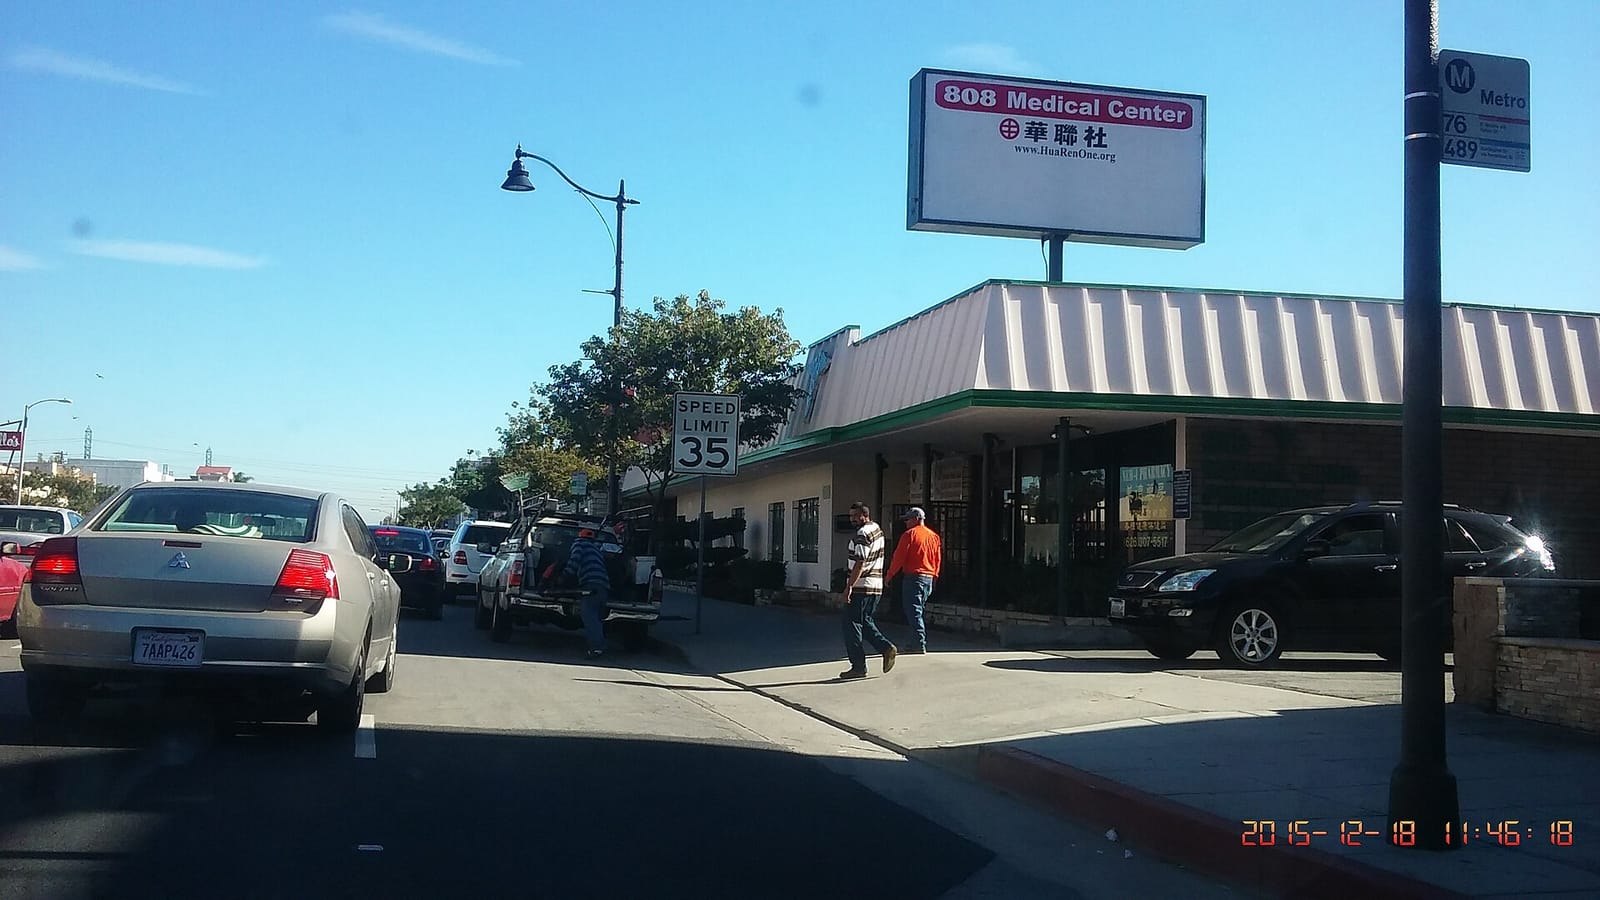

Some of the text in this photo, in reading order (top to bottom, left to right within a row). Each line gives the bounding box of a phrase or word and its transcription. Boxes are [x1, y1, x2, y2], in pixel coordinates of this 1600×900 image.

[943, 85, 1186, 123] 808 Medical Center
[1480, 89, 1527, 109] Metro
[1442, 113, 1467, 134] 76
[1024, 121, 1108, 149] 華聯社
[1015, 145, 1116, 163] www.HuaRenOne.org
[1444, 138, 1478, 159] 489
[678, 400, 736, 415] SPEED
[683, 419, 730, 433] LIMIT
[678, 436, 730, 468] 35
[142, 643, 196, 660] 7AAP426
